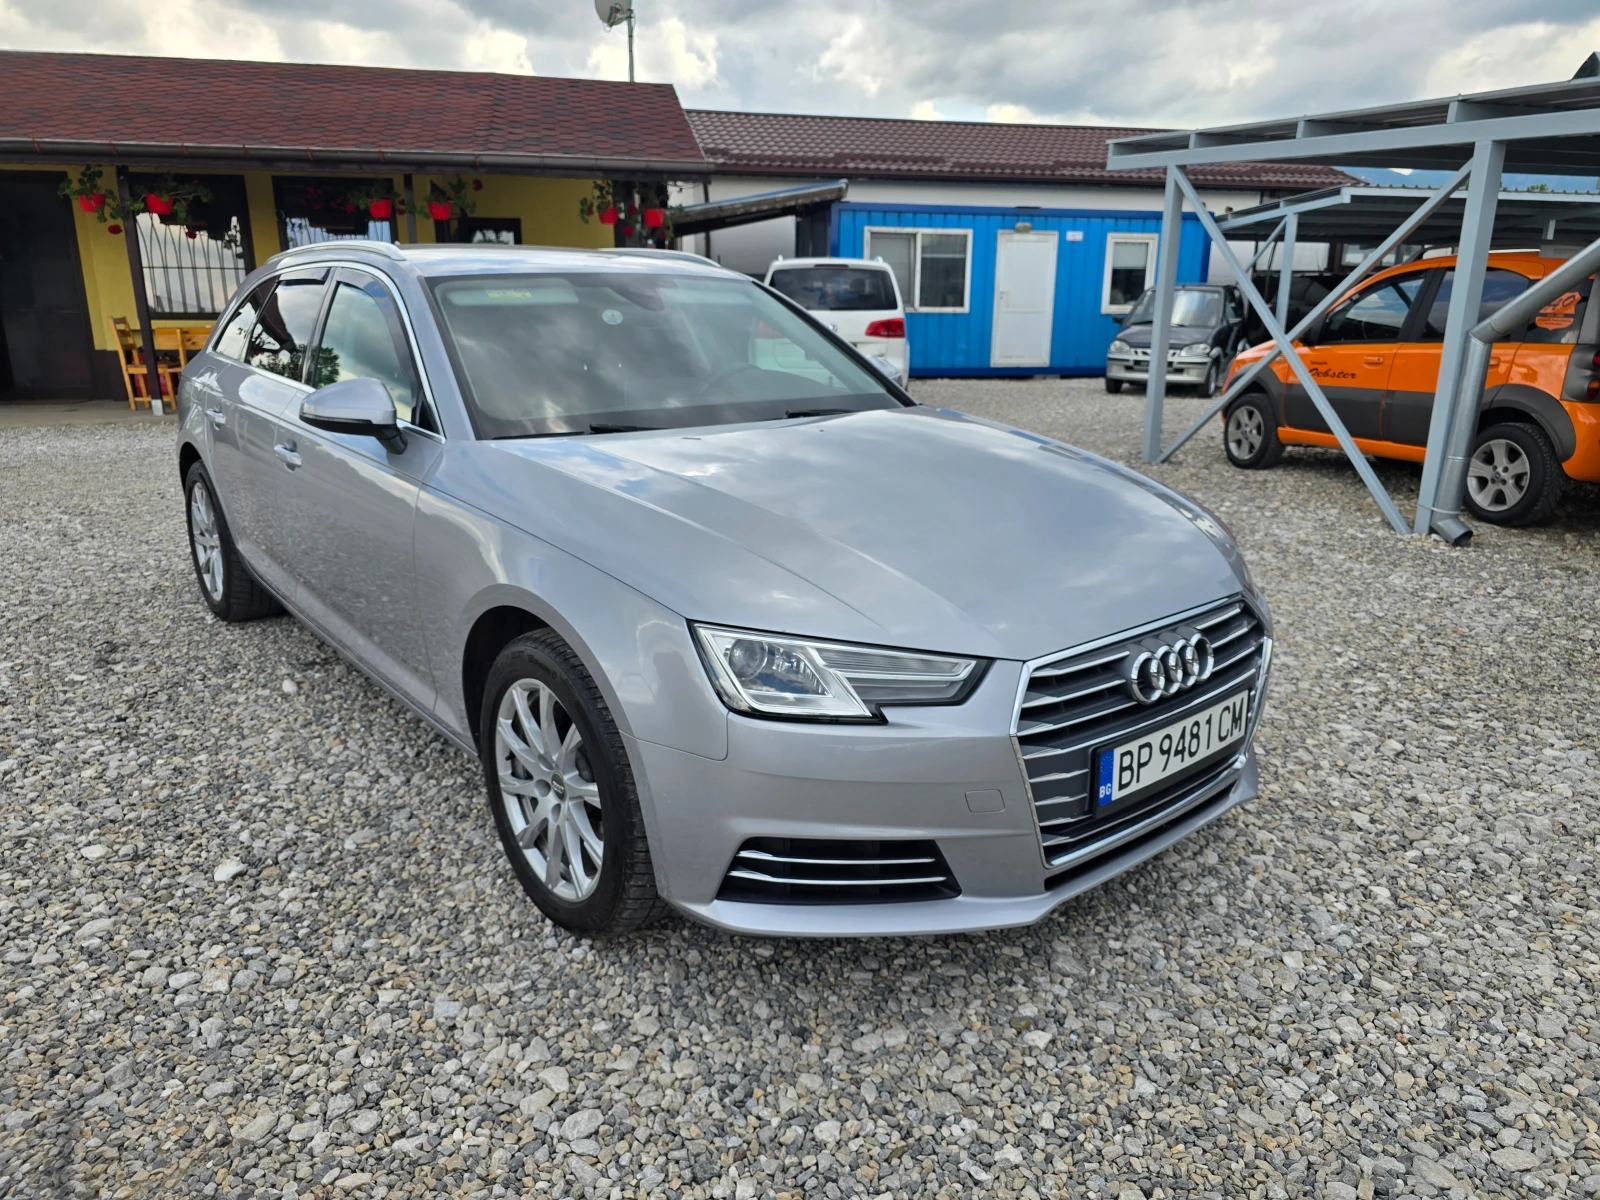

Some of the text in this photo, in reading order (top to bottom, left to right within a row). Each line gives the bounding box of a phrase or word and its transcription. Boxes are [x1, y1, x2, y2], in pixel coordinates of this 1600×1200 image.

[1118, 697, 1244, 792] BP 9481 CM
[1099, 783, 1112, 799] BG
